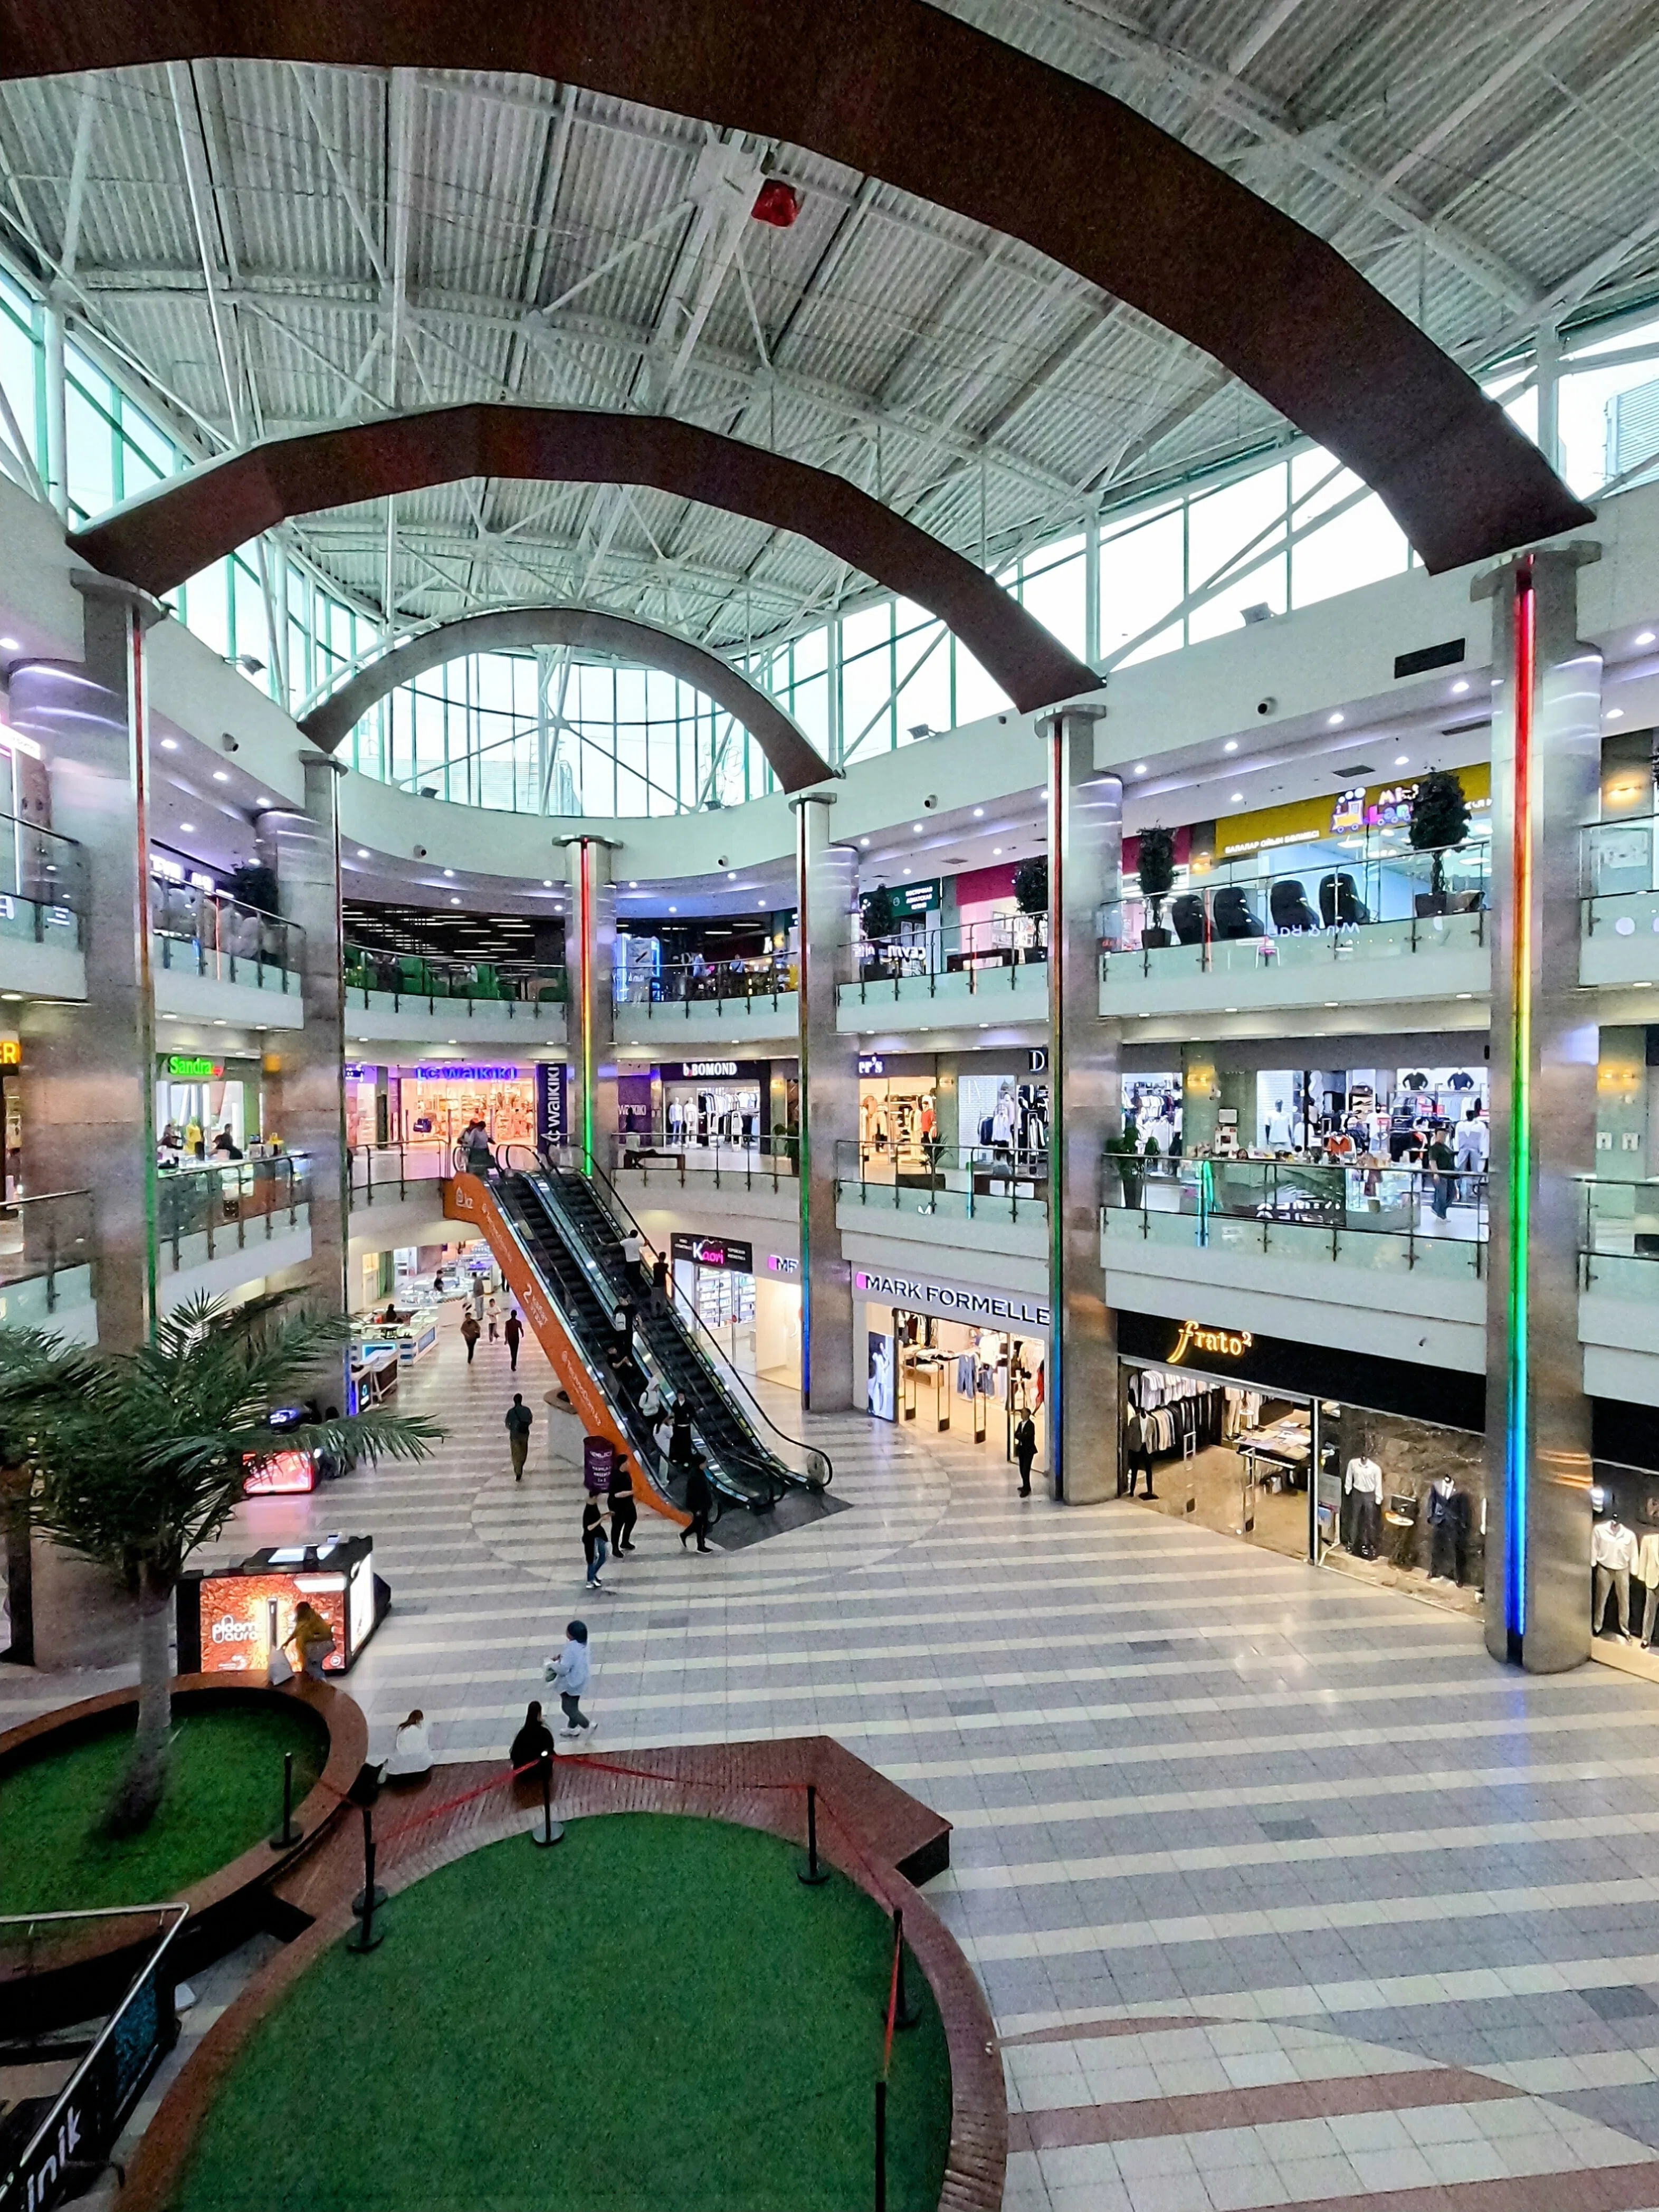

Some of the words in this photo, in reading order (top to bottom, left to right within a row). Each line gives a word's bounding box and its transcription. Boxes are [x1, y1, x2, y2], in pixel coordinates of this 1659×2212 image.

[169, 1056, 212, 1074] Sandra
[416, 1067, 440, 1081] LC
[692, 1241, 724, 1265] Kaori
[865, 1274, 923, 1300] MARK
[926, 1285, 1050, 1326] FORMELLE
[224, 1632, 259, 1642] aura
